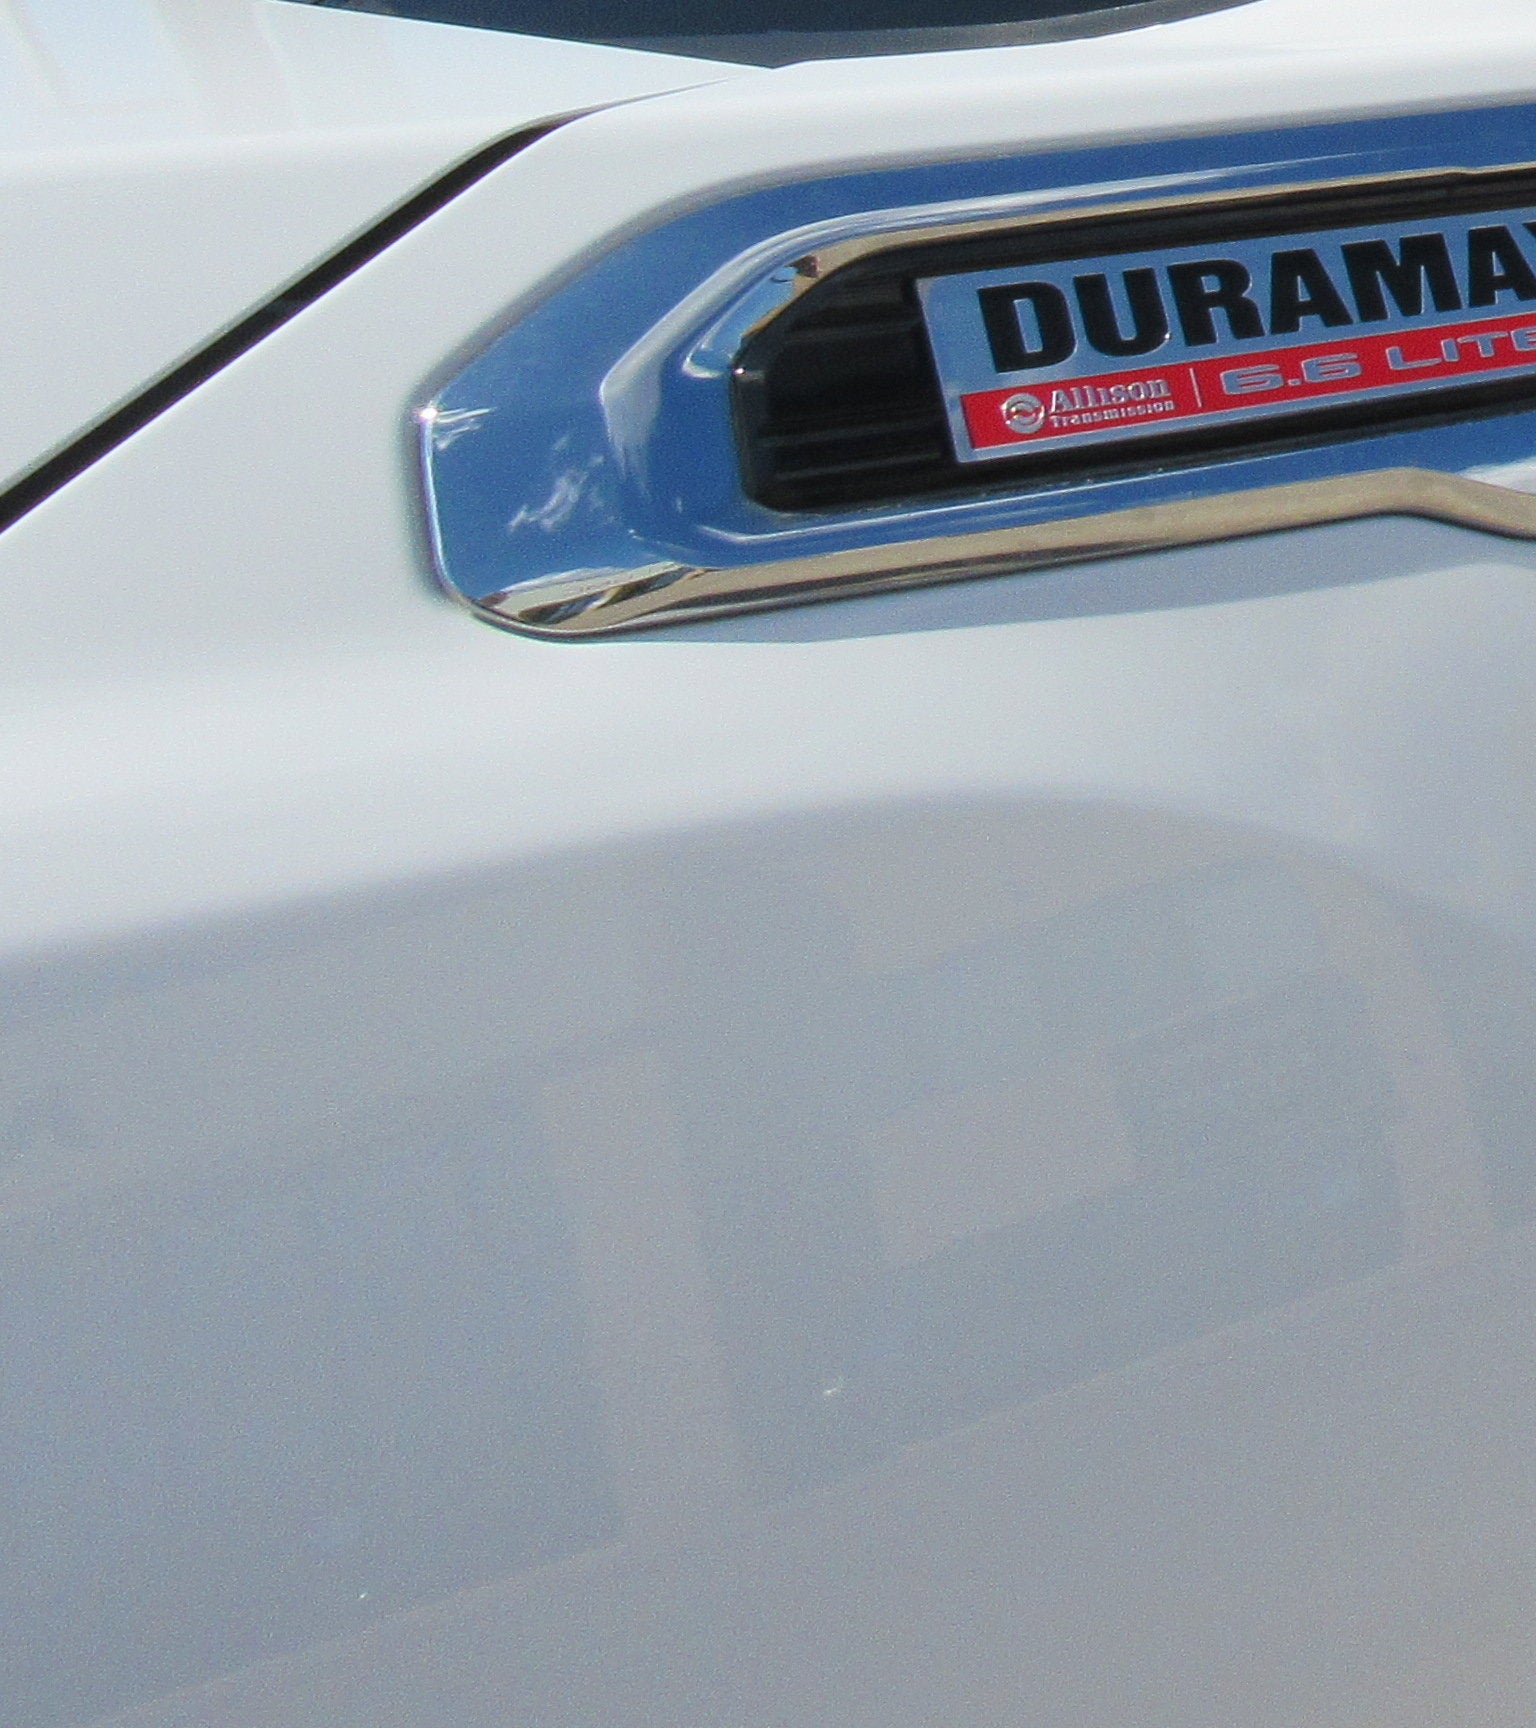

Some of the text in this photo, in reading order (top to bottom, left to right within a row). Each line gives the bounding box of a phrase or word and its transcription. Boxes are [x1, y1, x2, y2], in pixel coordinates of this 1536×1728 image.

[1220, 353, 1363, 396] 6.6
[1050, 378, 1172, 414] Allison
[1051, 400, 1175, 428] Transmission
